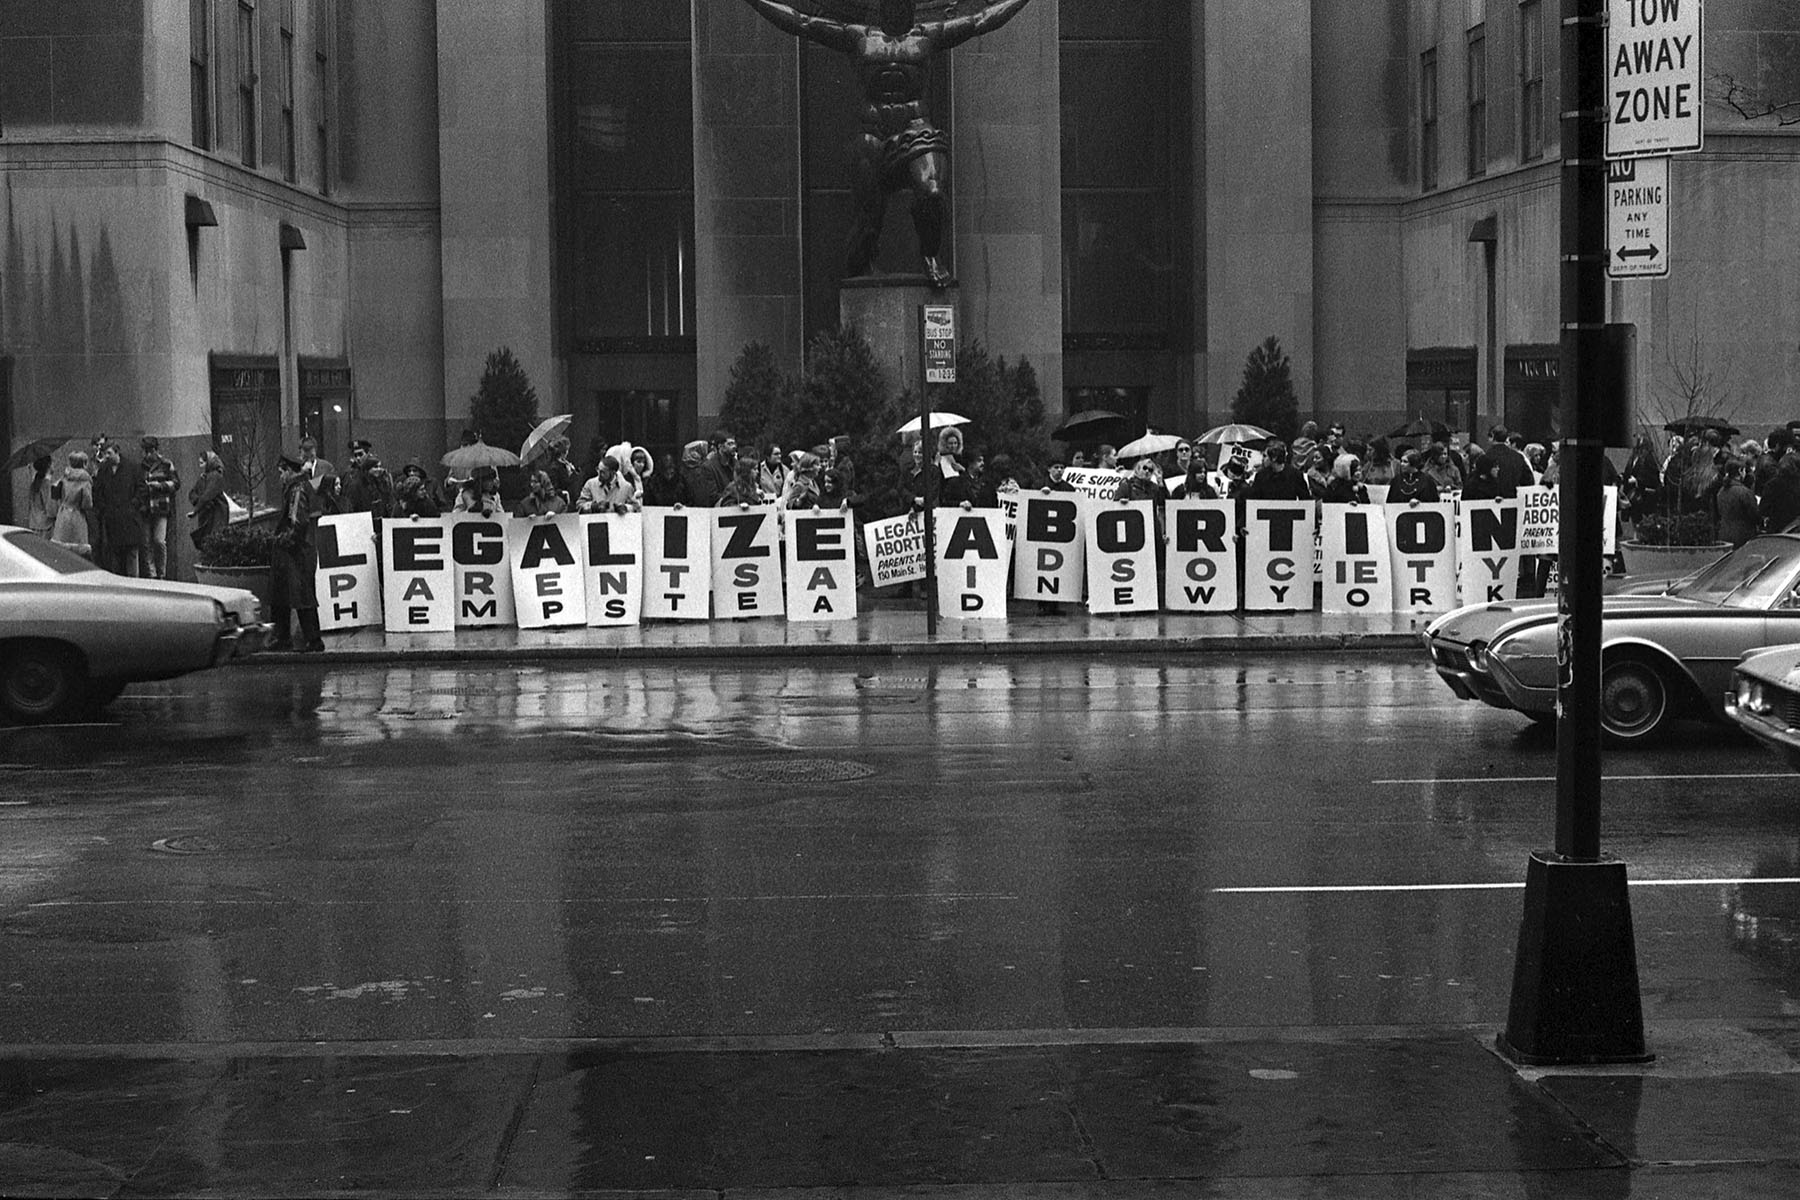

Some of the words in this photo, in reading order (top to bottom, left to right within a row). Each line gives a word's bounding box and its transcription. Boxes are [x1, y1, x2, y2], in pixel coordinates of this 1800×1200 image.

[1626, 0, 1680, 28] TOW
[1613, 34, 1693, 77] AWAY
[1614, 83, 1691, 125] ZONE
[1610, 160, 1632, 177] NO
[1613, 186, 1662, 207] PARKING
[1626, 211, 1648, 222] ANY
[1625, 228, 1651, 239] TIME
[933, 340, 946, 350] NO
[1066, 472, 1086, 484] WE
[1088, 475, 1121, 486] SUPP
[1099, 488, 1115, 500] CO
[1525, 492, 1559, 508] LEGA
[1523, 509, 1559, 525] ABOR
[874, 521, 925, 542] LEGAL
[1523, 527, 1555, 538] PARENTS
[878, 554, 915, 571] PARENTS
[890, 567, 907, 579] Main
